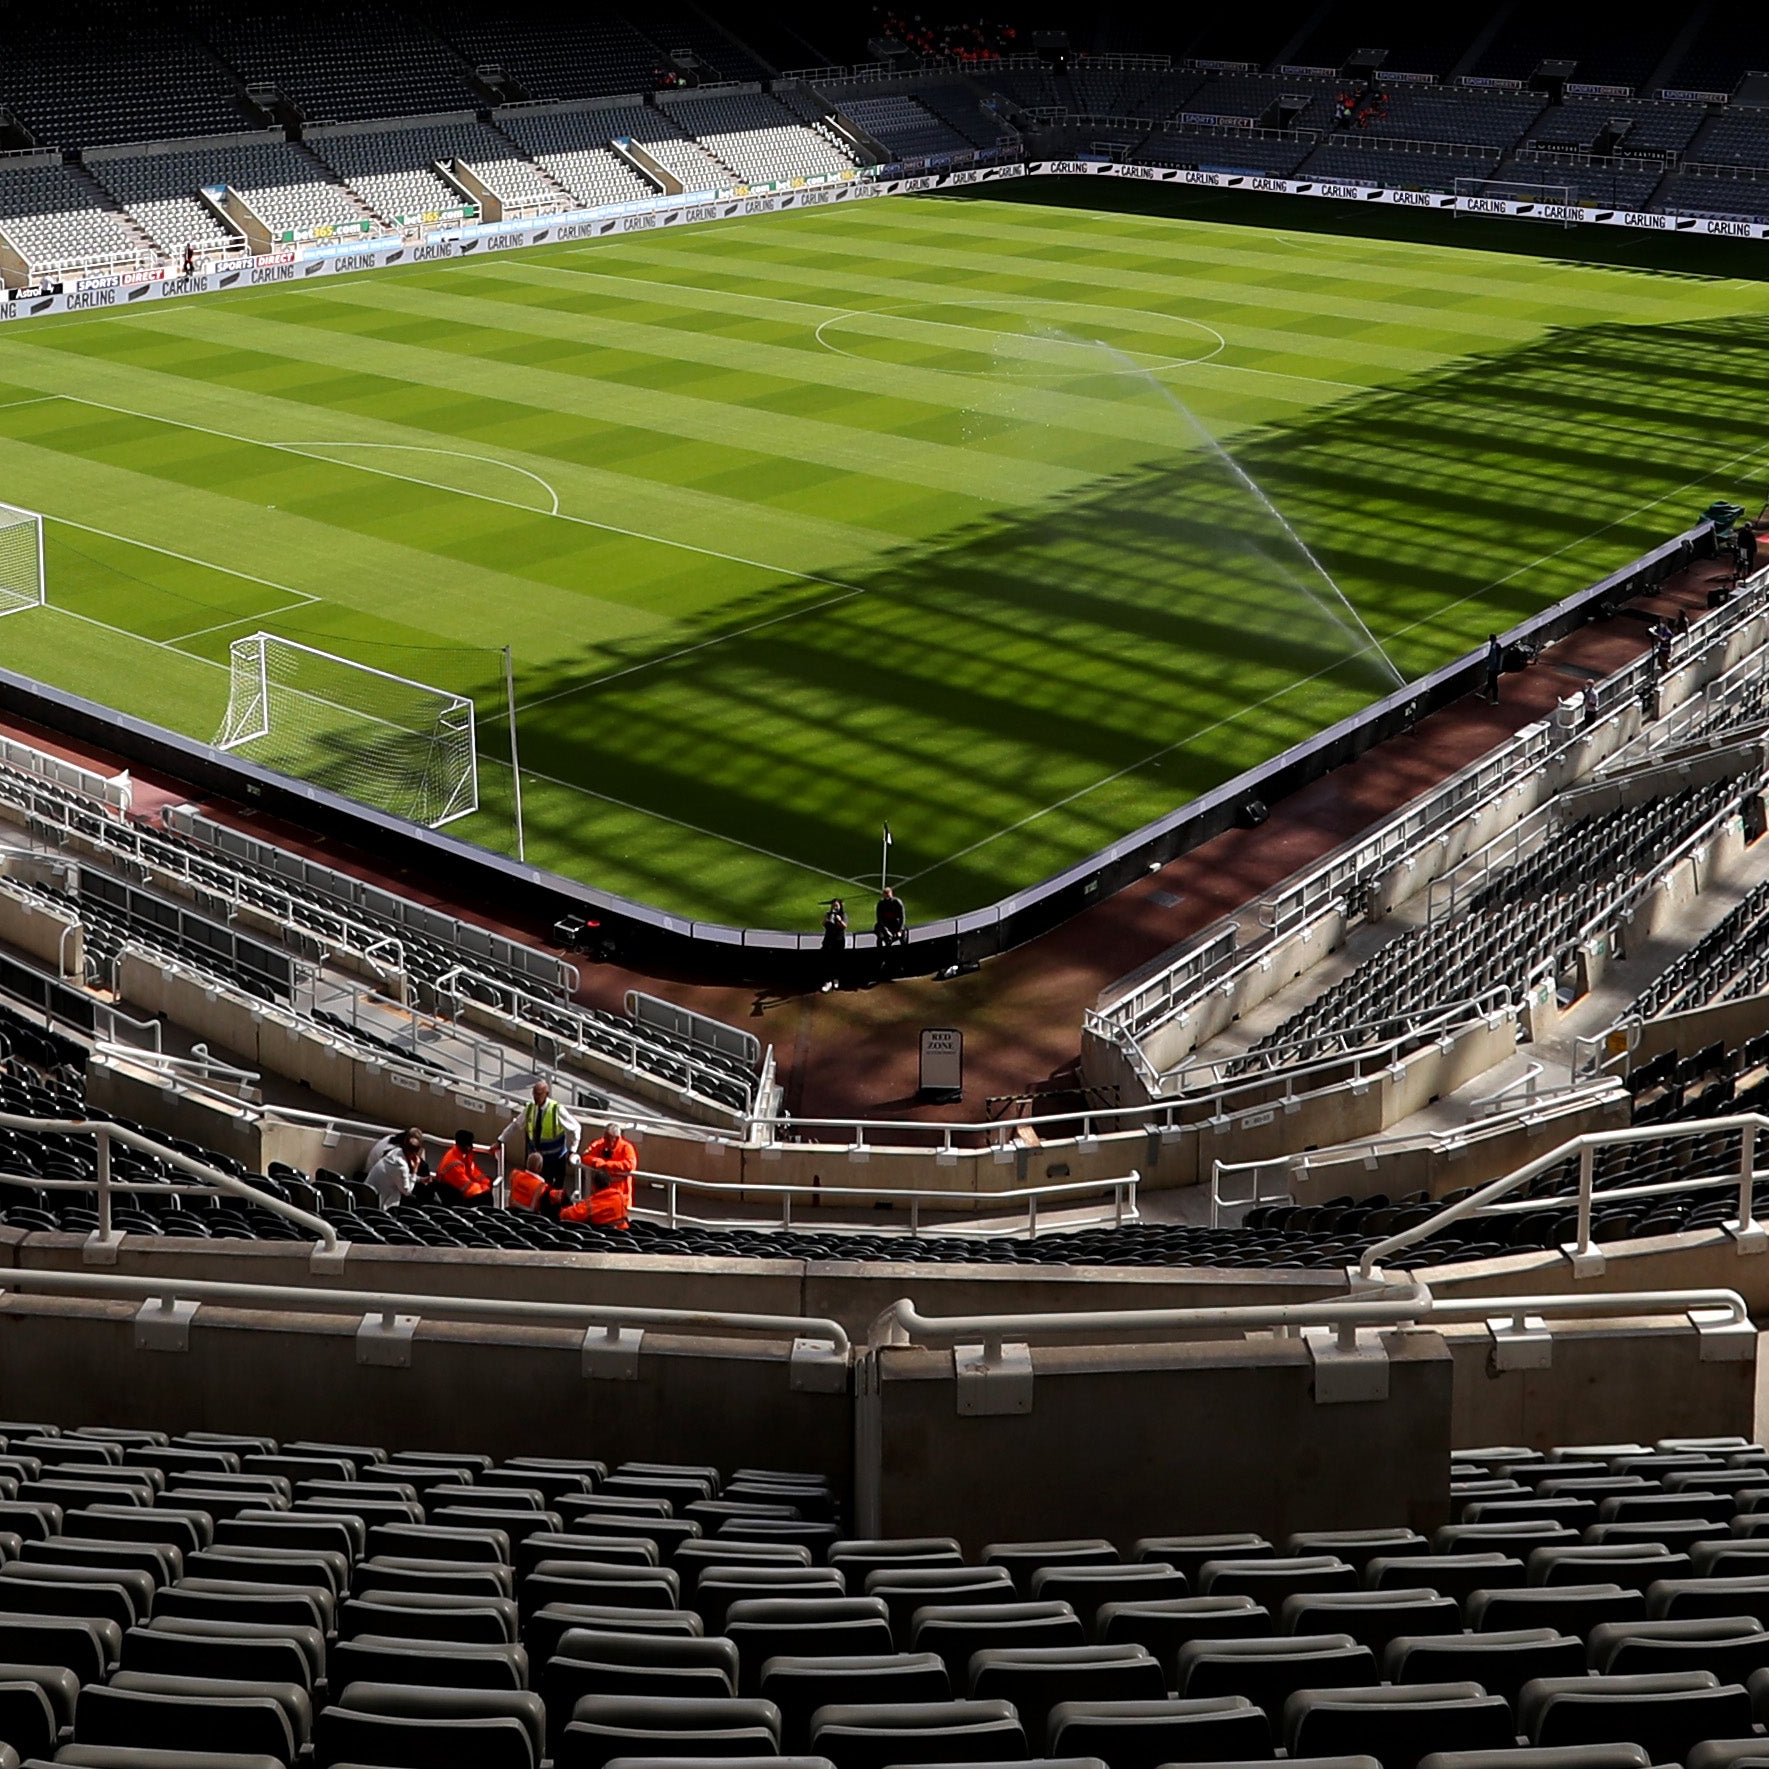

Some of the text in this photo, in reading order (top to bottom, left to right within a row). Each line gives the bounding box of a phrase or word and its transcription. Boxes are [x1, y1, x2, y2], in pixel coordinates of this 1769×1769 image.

[998, 164, 1022, 178] CARLING
[1050, 162, 1088, 174] CARLING
[1121, 166, 1154, 179] CARLING
[905, 177, 930, 191] CARLING
[953, 171, 978, 185] CARLING
[1185, 172, 1220, 185] CARLING
[1252, 178, 1287, 192] CARLING
[801, 191, 830, 206] CARLING
[1321, 185, 1358, 198] CARLING
[1393, 192, 1431, 206] CARLING
[745, 197, 775, 213] CARLING
[1467, 199, 1506, 212] CARLING
[404, 210, 464, 224] bet365.com
[685, 206, 717, 222] CARLING
[1544, 206, 1585, 220] CARLING
[1624, 213, 1666, 228] CARLING
[623, 215, 656, 231] CARLING
[1707, 221, 1751, 236] CARLING
[293, 222, 361, 241] bet365.com
[557, 224, 592, 240] CARLING
[487, 233, 524, 250] CARLING
[413, 243, 452, 262] CARLING
[216, 253, 295, 273] SPORTS DIRECT
[334, 254, 375, 273] CARLING
[78, 269, 165, 291] SPORTS DIRECT
[251, 265, 294, 284] CARLING
[162, 276, 209, 297] CARLING
[66, 289, 115, 309] CARLING
[931, 1033, 952, 1041] RED
[927, 1041, 955, 1050] ZONE
